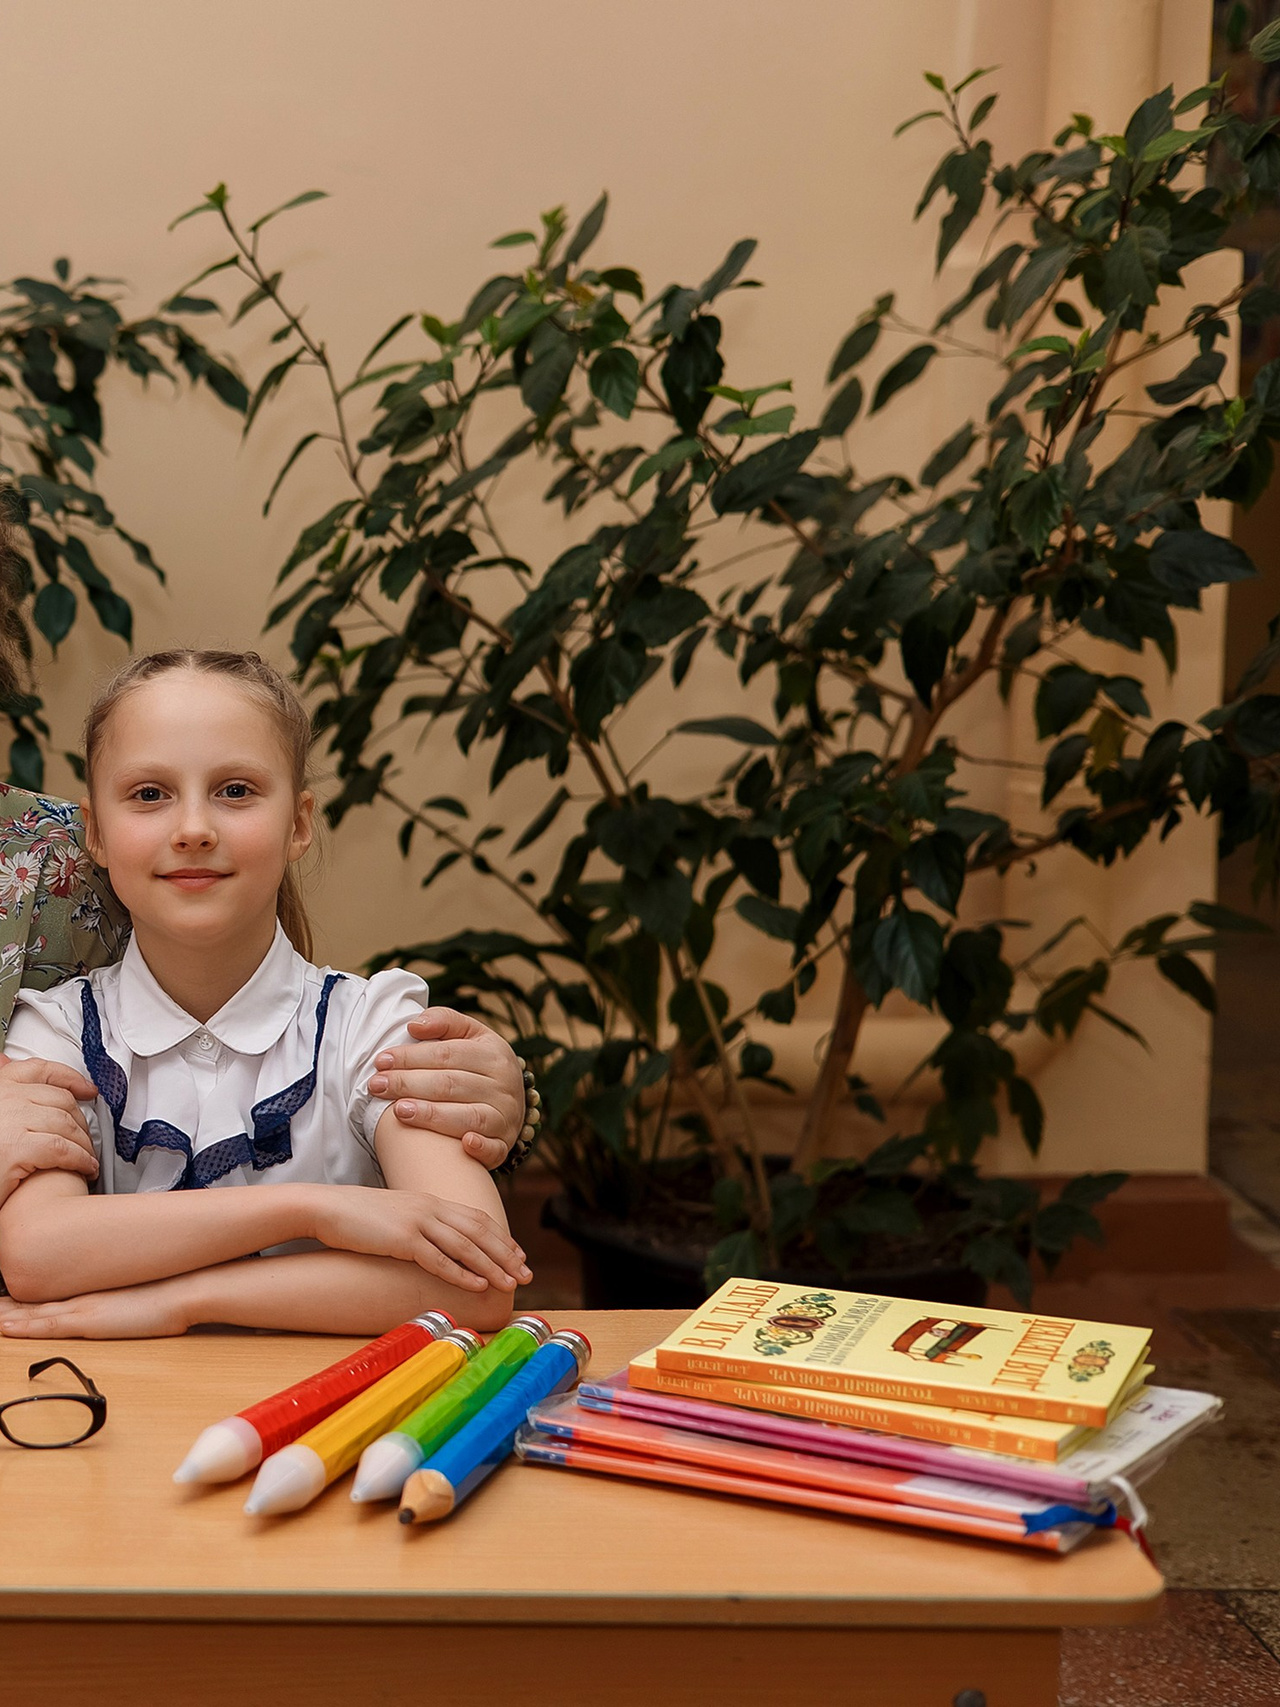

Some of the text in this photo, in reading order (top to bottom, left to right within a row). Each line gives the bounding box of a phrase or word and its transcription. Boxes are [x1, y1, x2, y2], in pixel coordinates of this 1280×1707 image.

[679, 1284, 781, 1351] В. И. ДАЛЬ
[991, 1318, 1076, 1393] ДЛЯ ДЕТЕЙ
[733, 1387, 890, 1425] ТОЛКОВЫЙ СЛОВАРЬ
[769, 1368, 935, 1401] ТОЛКОВЫЙ СЛОВАРЬ
